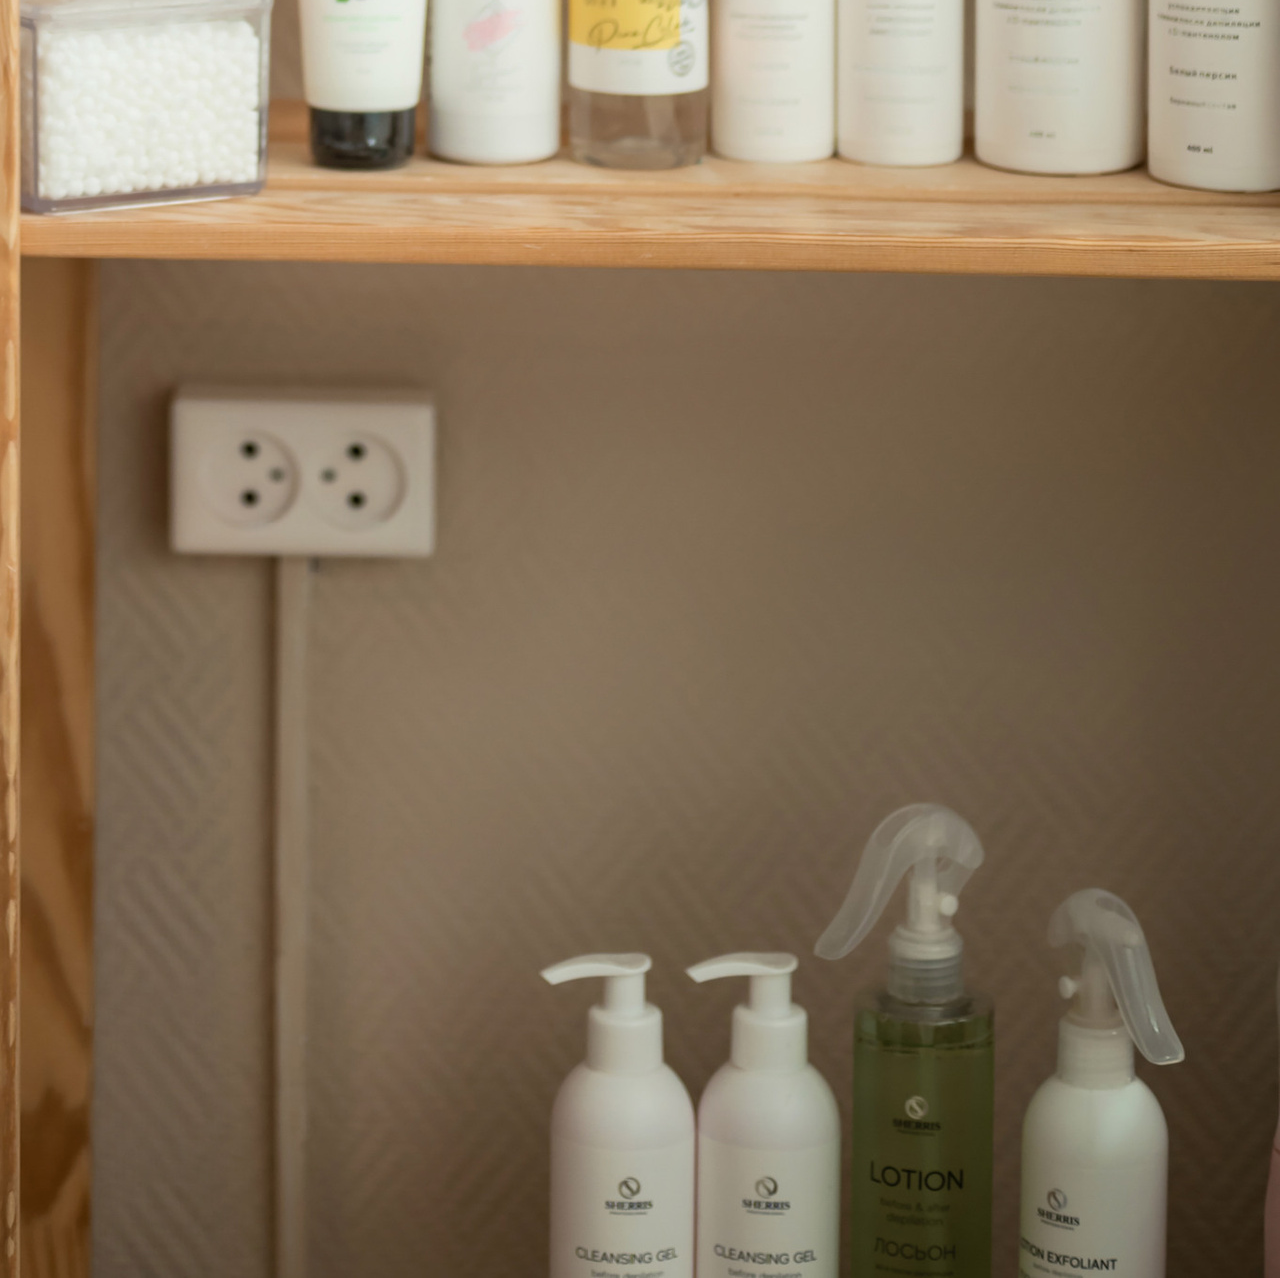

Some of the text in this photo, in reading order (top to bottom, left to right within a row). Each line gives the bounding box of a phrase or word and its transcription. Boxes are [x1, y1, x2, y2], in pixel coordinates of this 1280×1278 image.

[870, 1159, 964, 1192] LOTION
[604, 1200, 654, 1211] SHERRIS
[741, 1198, 792, 1211] SHERRIS
[1036, 1207, 1081, 1227] SHERRIS
[575, 1245, 679, 1266] CLEANSING GEL
[713, 1243, 819, 1266] CLEANSING GEL
[873, 1236, 957, 1262] ЛОСЬОН
[1046, 1250, 1118, 1271] EXFOLIANT
